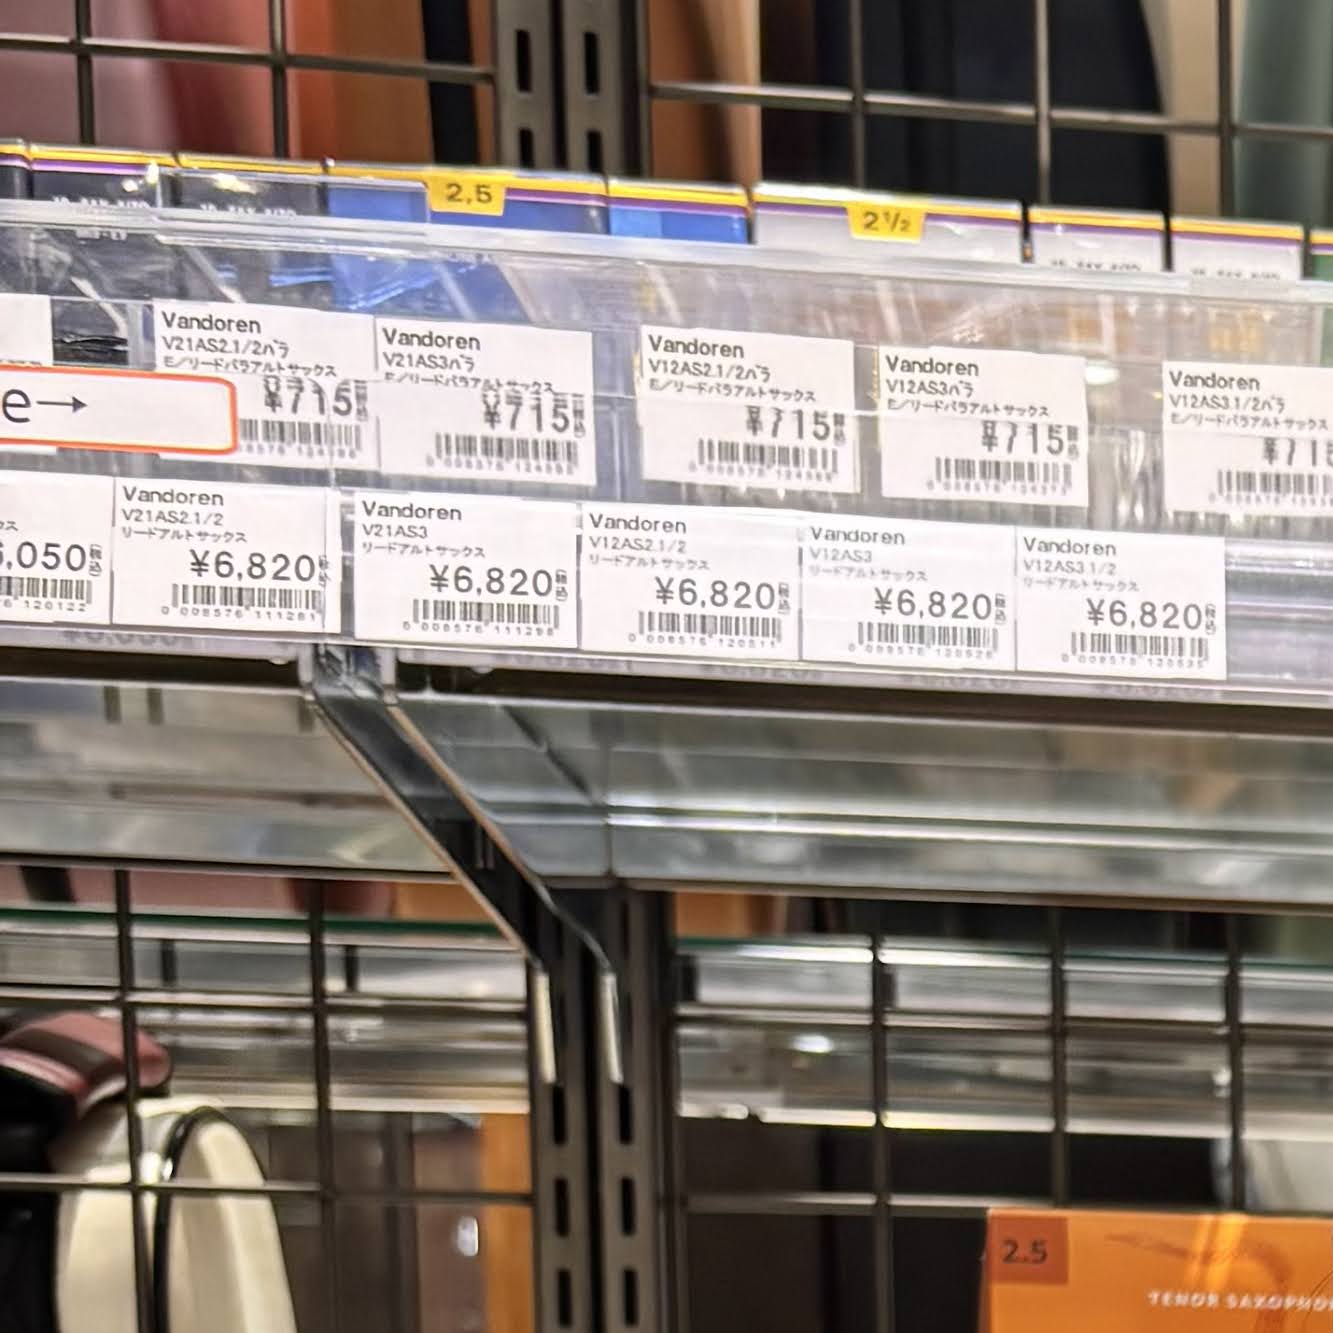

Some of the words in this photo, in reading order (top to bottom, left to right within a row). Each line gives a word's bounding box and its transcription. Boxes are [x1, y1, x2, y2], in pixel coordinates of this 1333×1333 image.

[445, 183, 493, 204] 2.5
[162, 311, 261, 334] Vandoren
[382, 327, 480, 351] Vandoren
[648, 335, 744, 358] Vandoren
[886, 356, 979, 376] Vandoren
[1169, 371, 1260, 391] Vandoren
[264, 378, 352, 417] ¥715
[482, 396, 570, 433] ¥715
[746, 405, 831, 441] ¥715
[981, 420, 1065, 455] ¥715
[123, 486, 225, 507] Vandoren
[362, 500, 462, 521] Vandoren
[362, 524, 429, 539] V21AS3
[589, 513, 687, 534] Vandoren
[810, 526, 905, 546] Vandoren
[1024, 536, 1117, 556] Vandoren
[188, 549, 316, 582] ¥6,820
[429, 564, 552, 597] ¥6,820
[654, 576, 776, 610] ¥6,820
[874, 586, 992, 620] ¥6,820
[1086, 597, 1202, 630] ¥6,820
[1001, 1238, 1048, 1266] 2.5
[1149, 1290, 1220, 1309] TENOR
